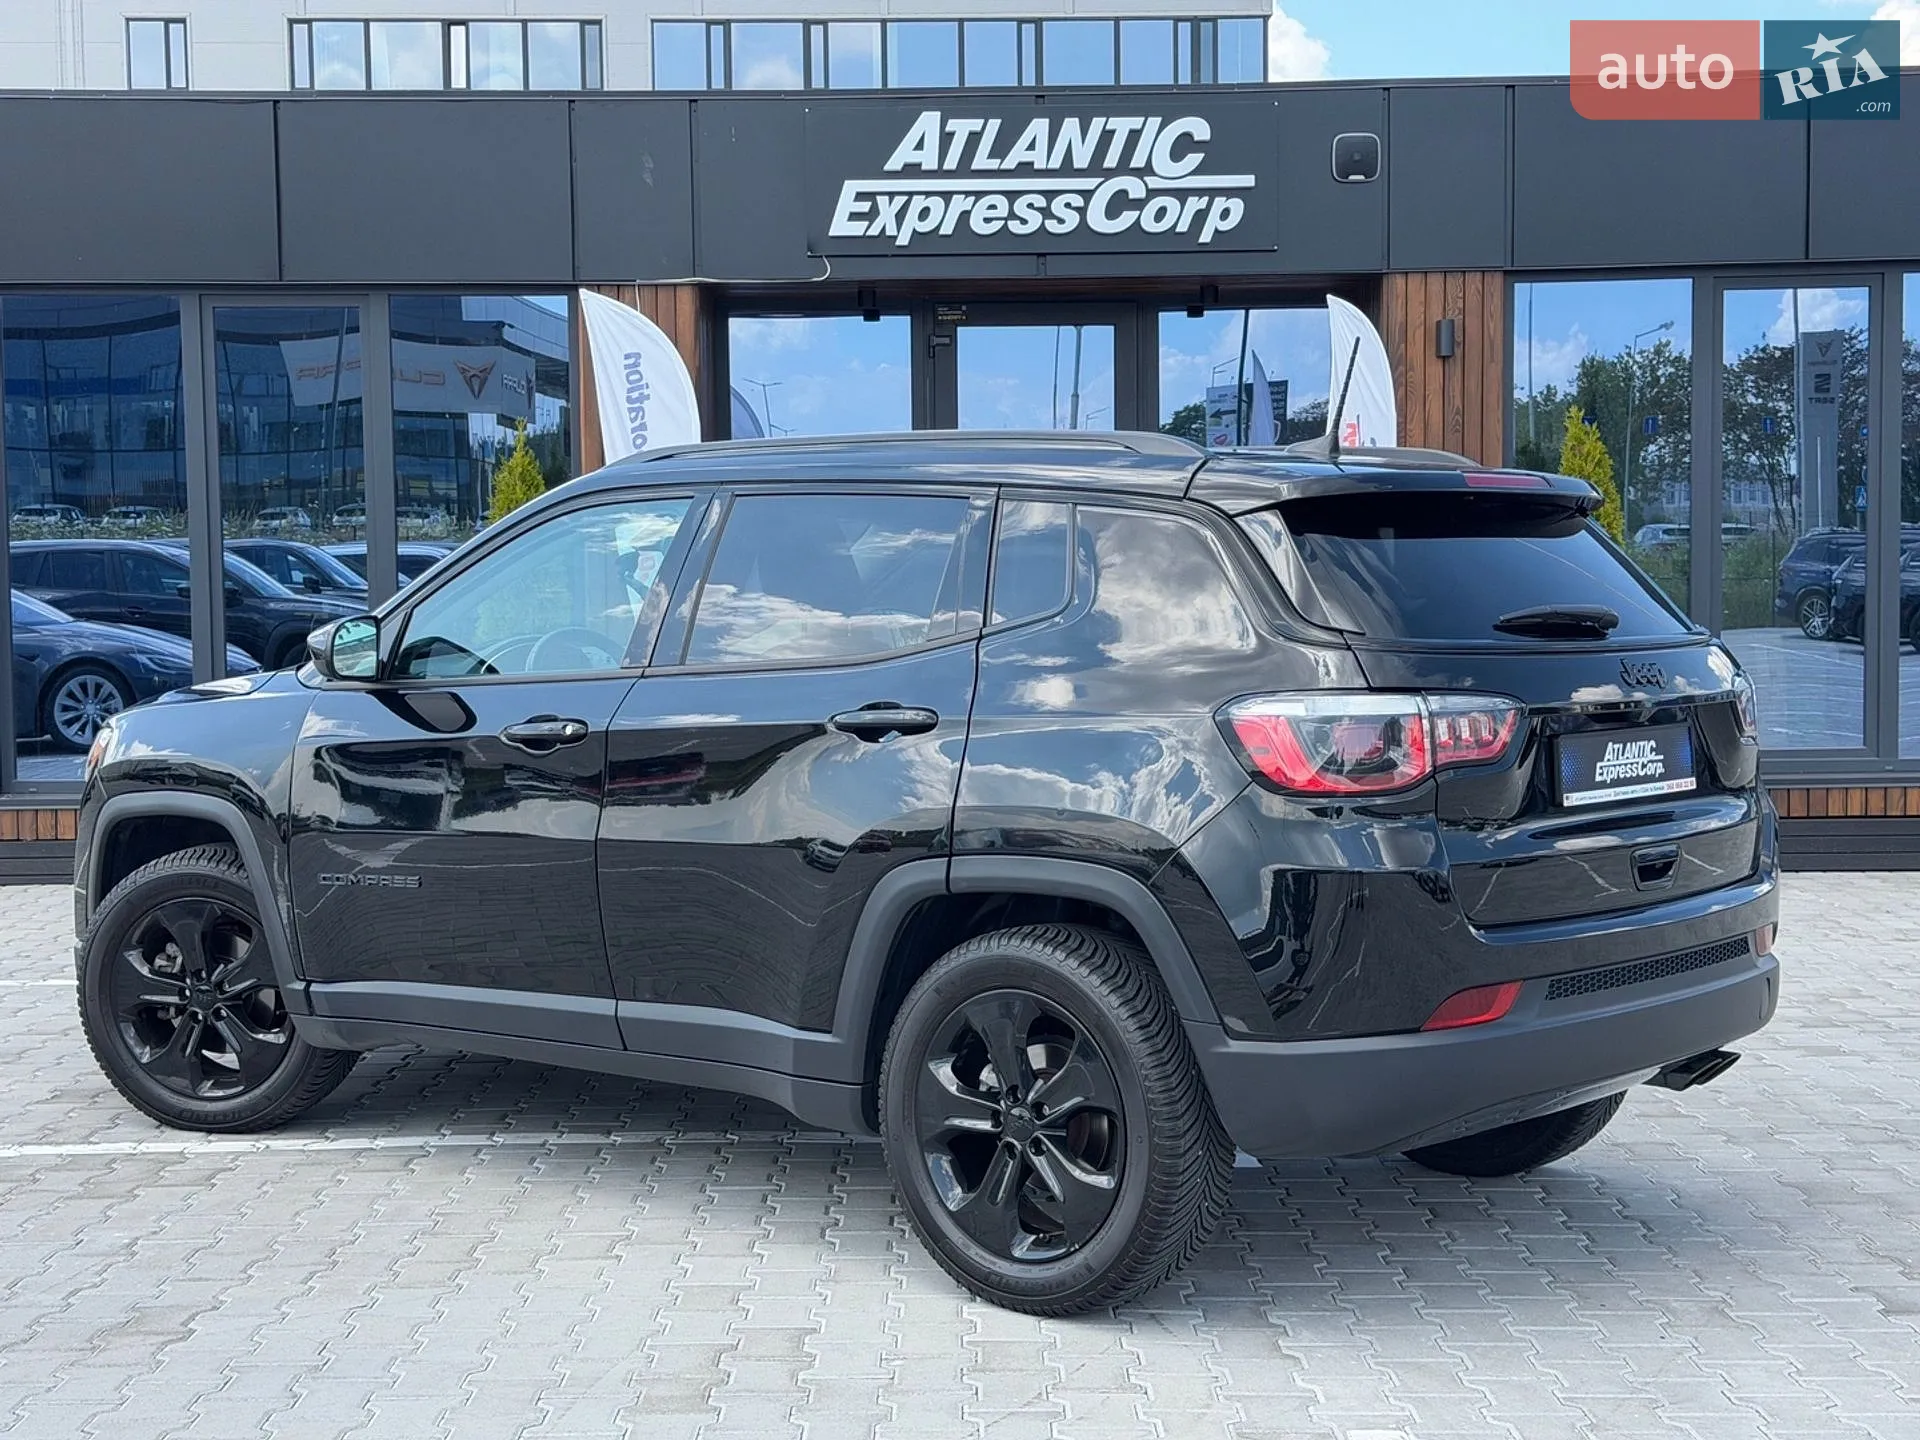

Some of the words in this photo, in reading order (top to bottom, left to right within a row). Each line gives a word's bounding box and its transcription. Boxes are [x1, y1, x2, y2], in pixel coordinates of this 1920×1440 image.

[883, 111, 1211, 179] ATLANTIC
[828, 176, 1246, 246] ExpressCorp
[1619, 658, 1666, 689] Jeep
[1603, 740, 1657, 762] ATLANTIC
[318, 873, 421, 888] COMPASS
